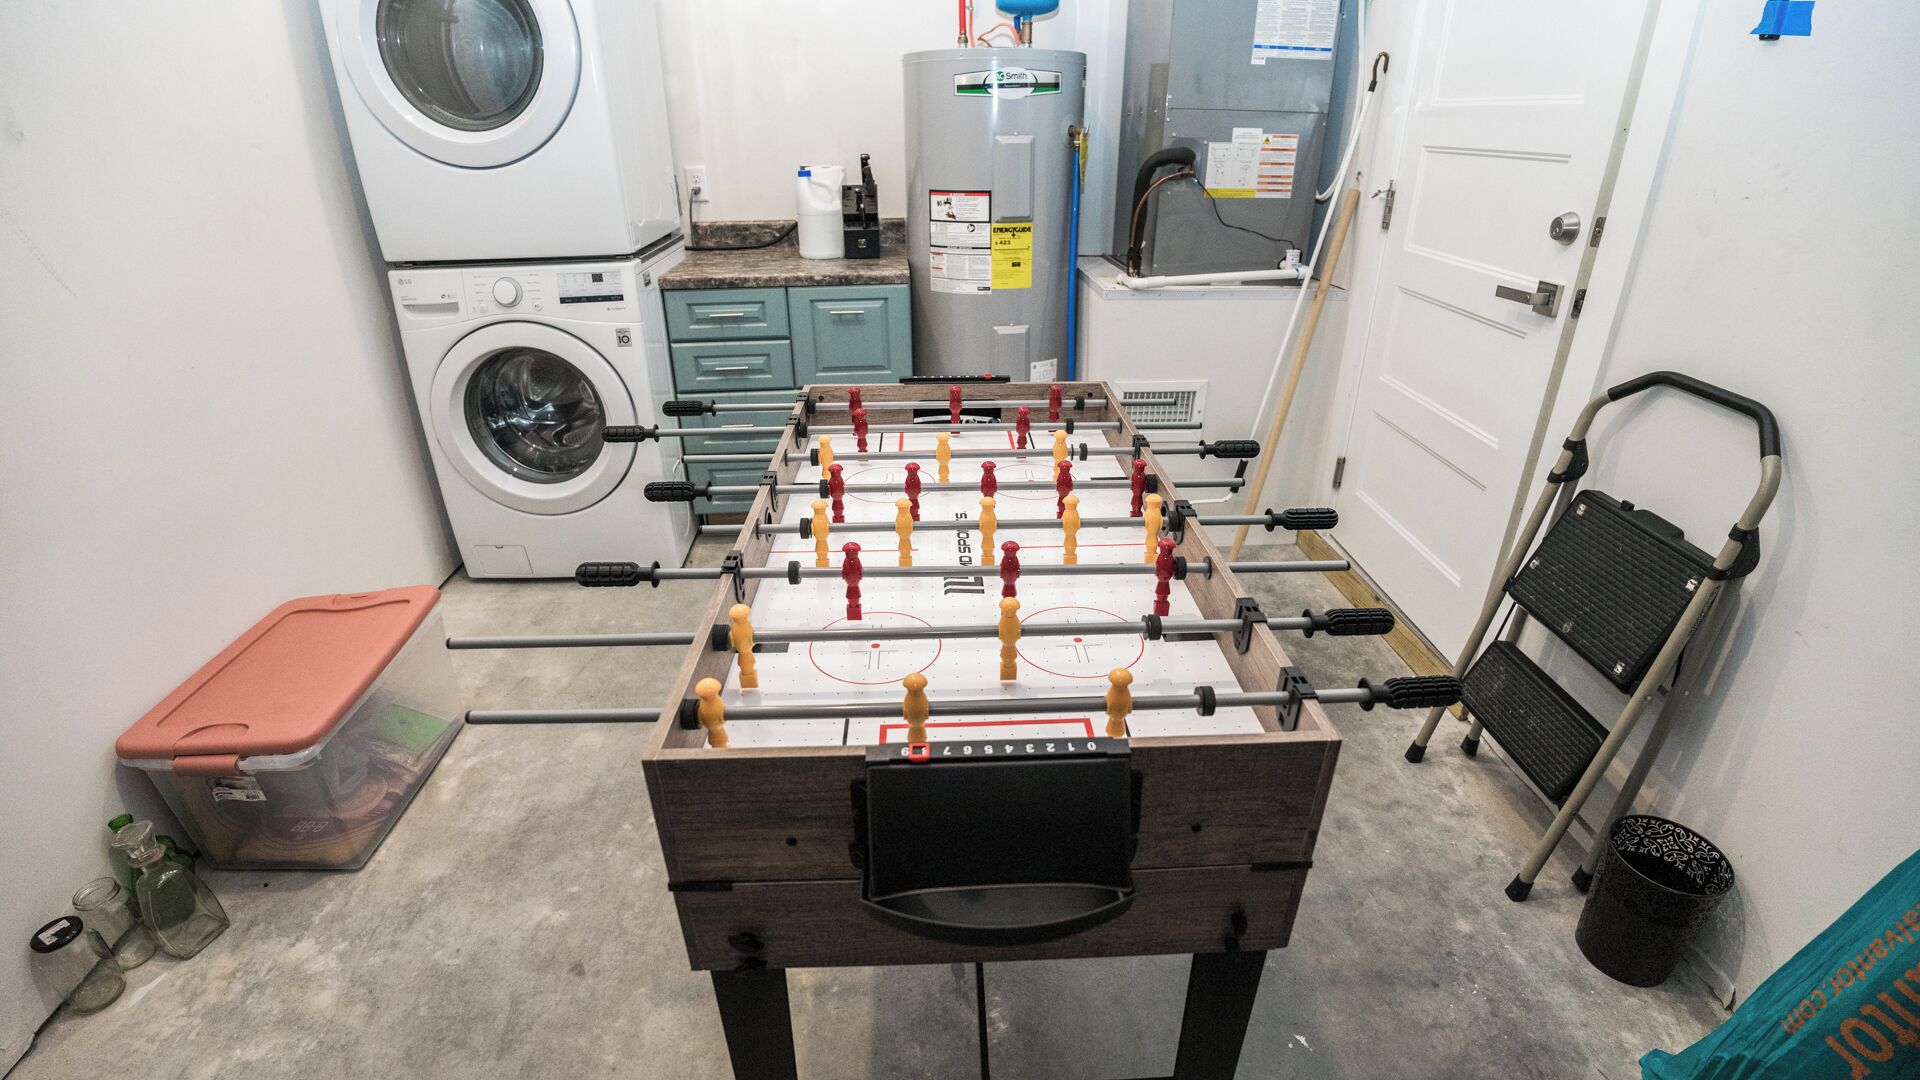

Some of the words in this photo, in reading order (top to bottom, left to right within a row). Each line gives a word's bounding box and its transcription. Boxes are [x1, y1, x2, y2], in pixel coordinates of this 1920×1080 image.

[943, 746, 952, 756] 7
[963, 745, 973, 755] 6
[983, 745, 994, 754] 5
[1004, 744, 1014, 754] 4
[1025, 743, 1035, 753] 3
[1045, 743, 1056, 753] 2
[1067, 742, 1076, 752] 1
[1087, 741, 1097, 751] 0
